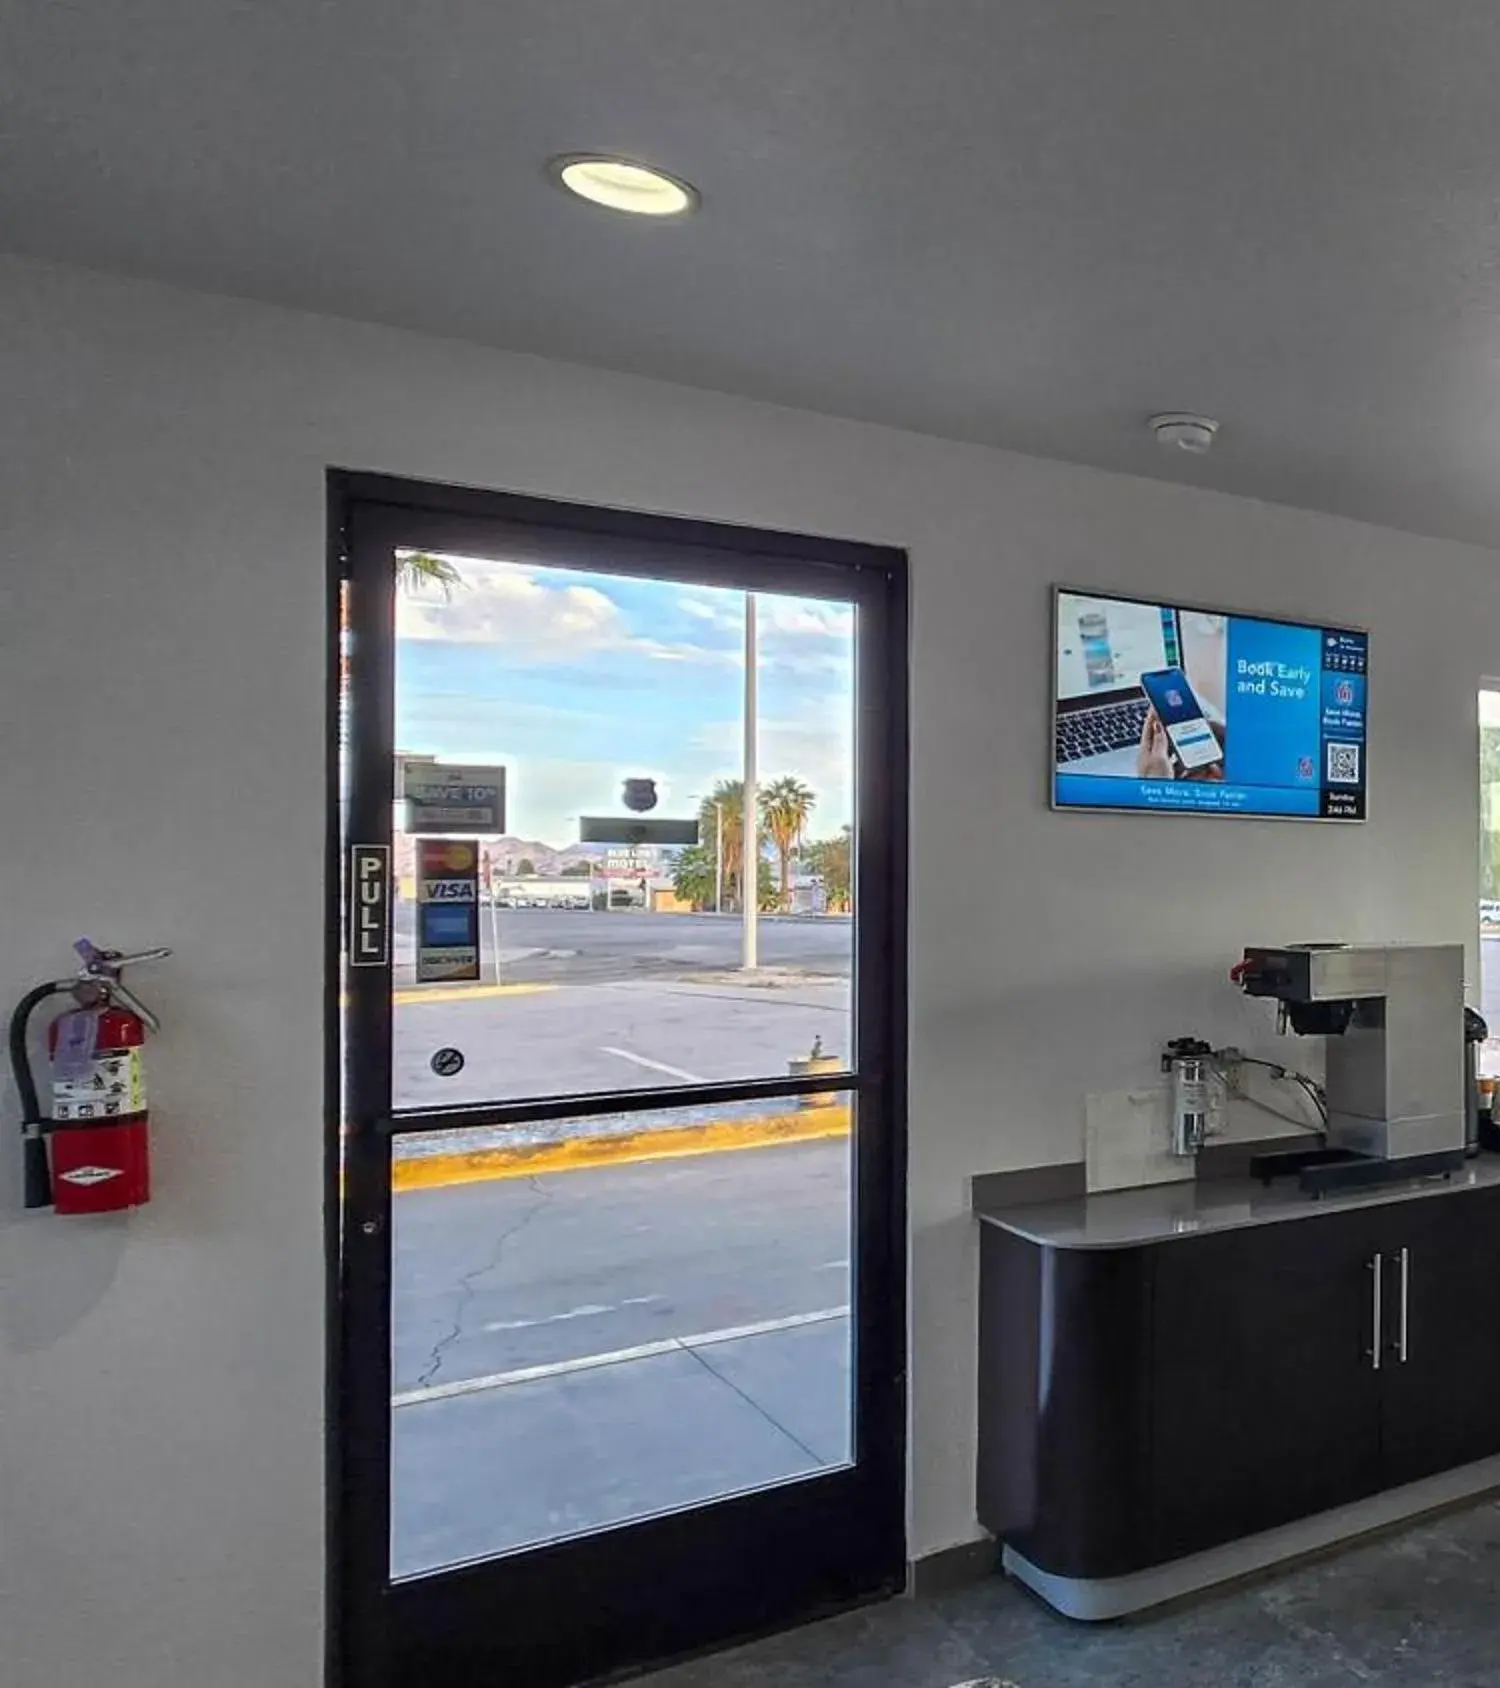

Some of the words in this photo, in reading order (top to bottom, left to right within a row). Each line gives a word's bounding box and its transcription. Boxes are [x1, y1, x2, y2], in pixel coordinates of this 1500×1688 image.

[1237, 659, 1275, 677] Book
[1278, 663, 1311, 685] Early
[1237, 679, 1266, 695] and
[1270, 680, 1306, 699] Save
[425, 883, 473, 898] VISA
[359, 856, 382, 954] PULL
